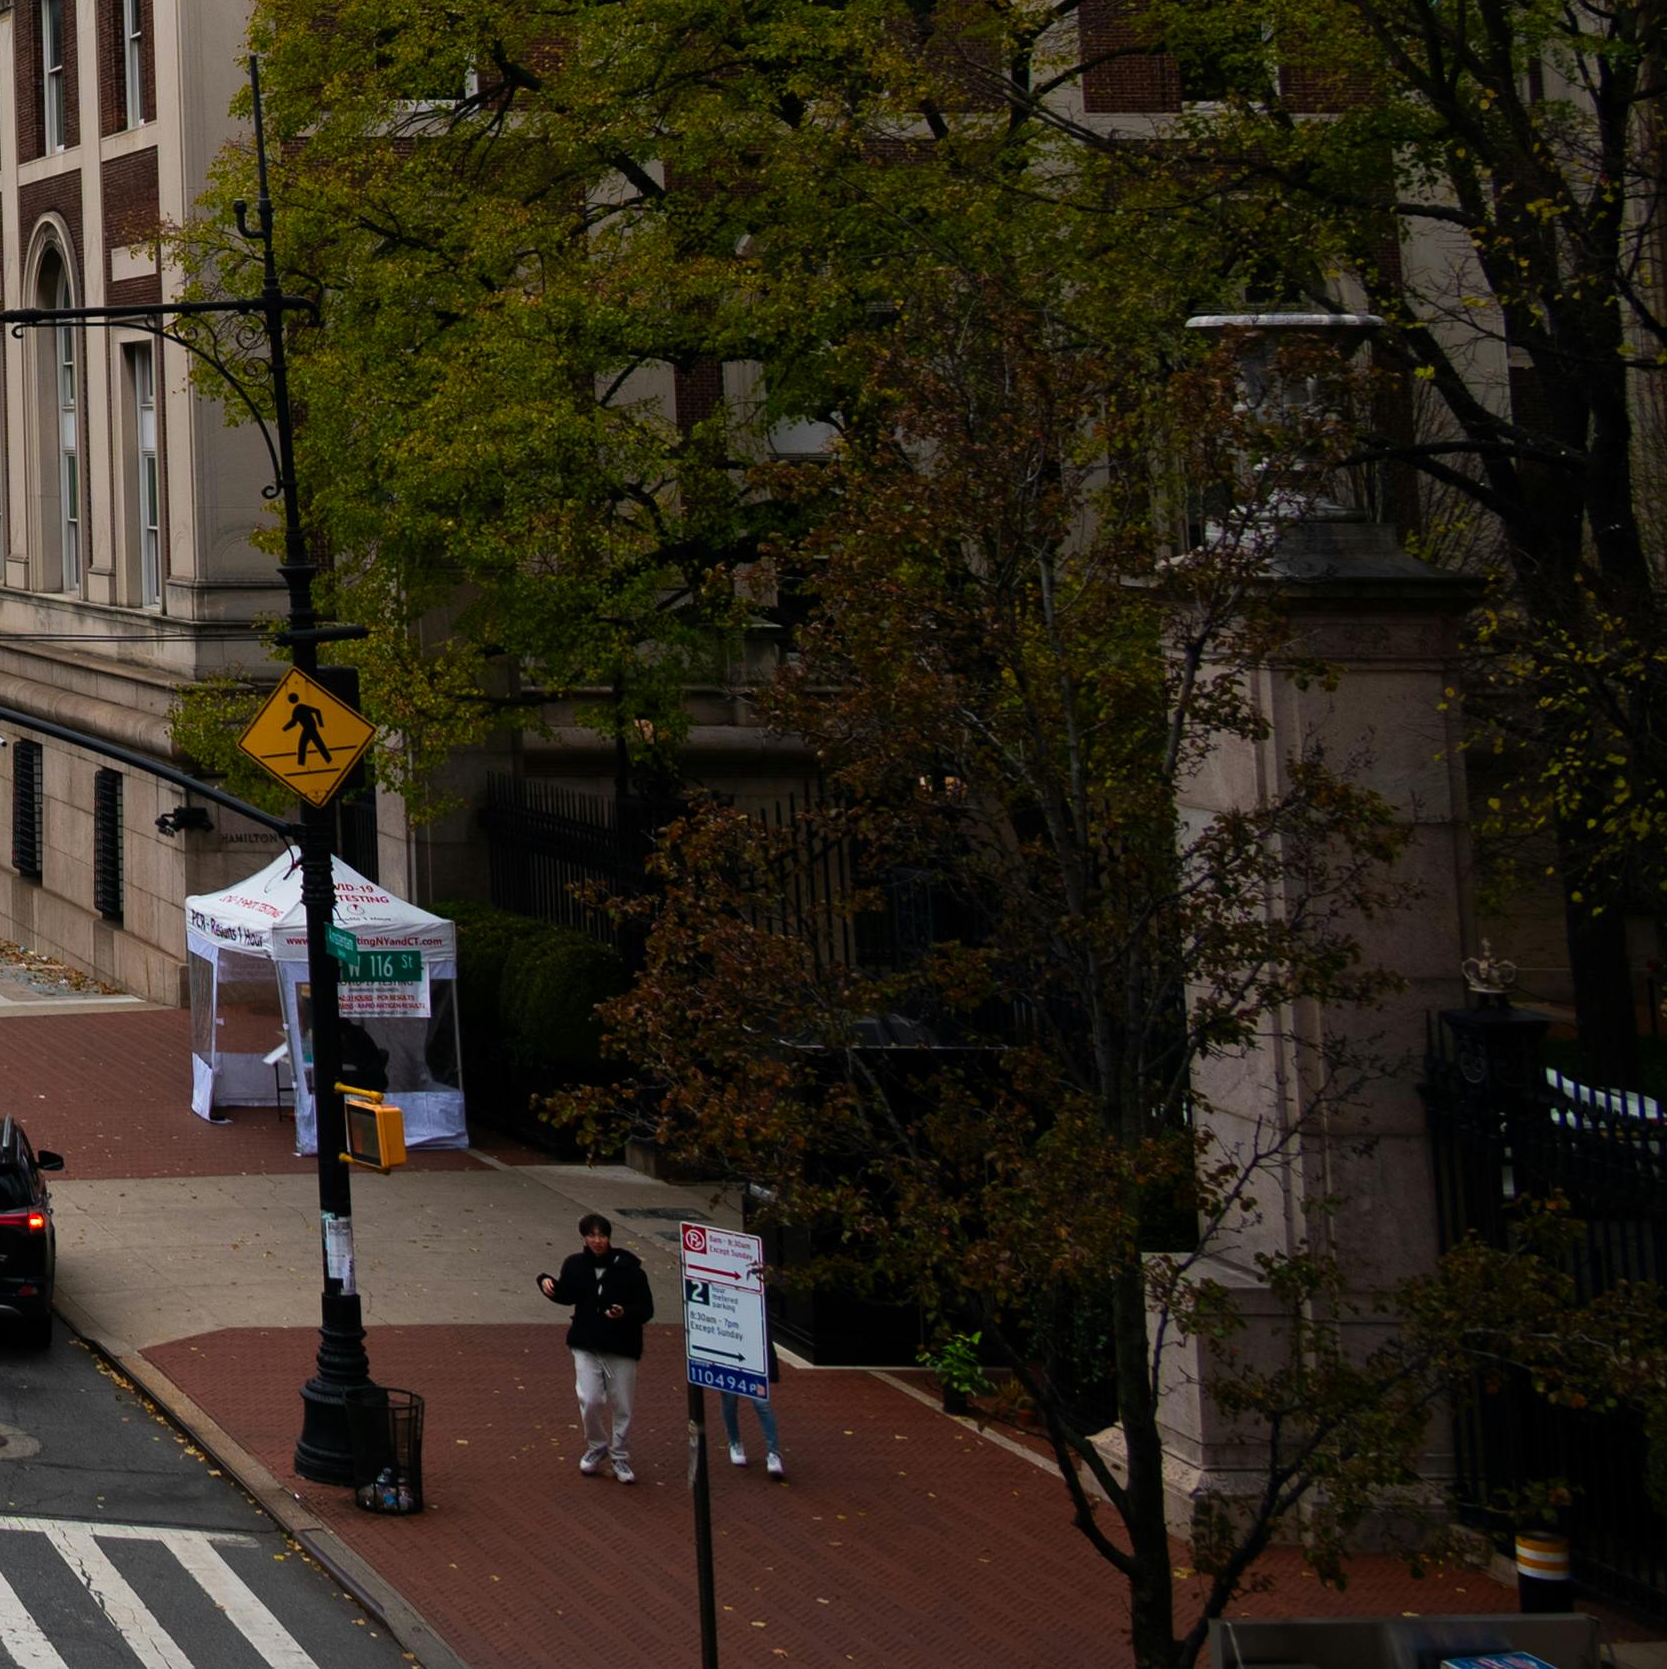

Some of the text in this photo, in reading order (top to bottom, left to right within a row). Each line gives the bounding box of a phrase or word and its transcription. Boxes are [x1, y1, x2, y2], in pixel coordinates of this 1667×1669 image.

[220, 833, 278, 844] HAMILTON
[333, 882, 374, 893] VID-19
[339, 894, 390, 904] TESTING
[190, 909, 206, 930] PCR
[244, 928, 263, 948] Hour
[349, 955, 413, 978] W 116 St
[710, 1246, 753, 1261] Except Sunday
[691, 1281, 704, 1302] 2
[712, 1293, 738, 1305] metered
[712, 1301, 736, 1313] parking
[724, 1318, 740, 1330] 7pm
[690, 1321, 743, 1342] Except Sunday
